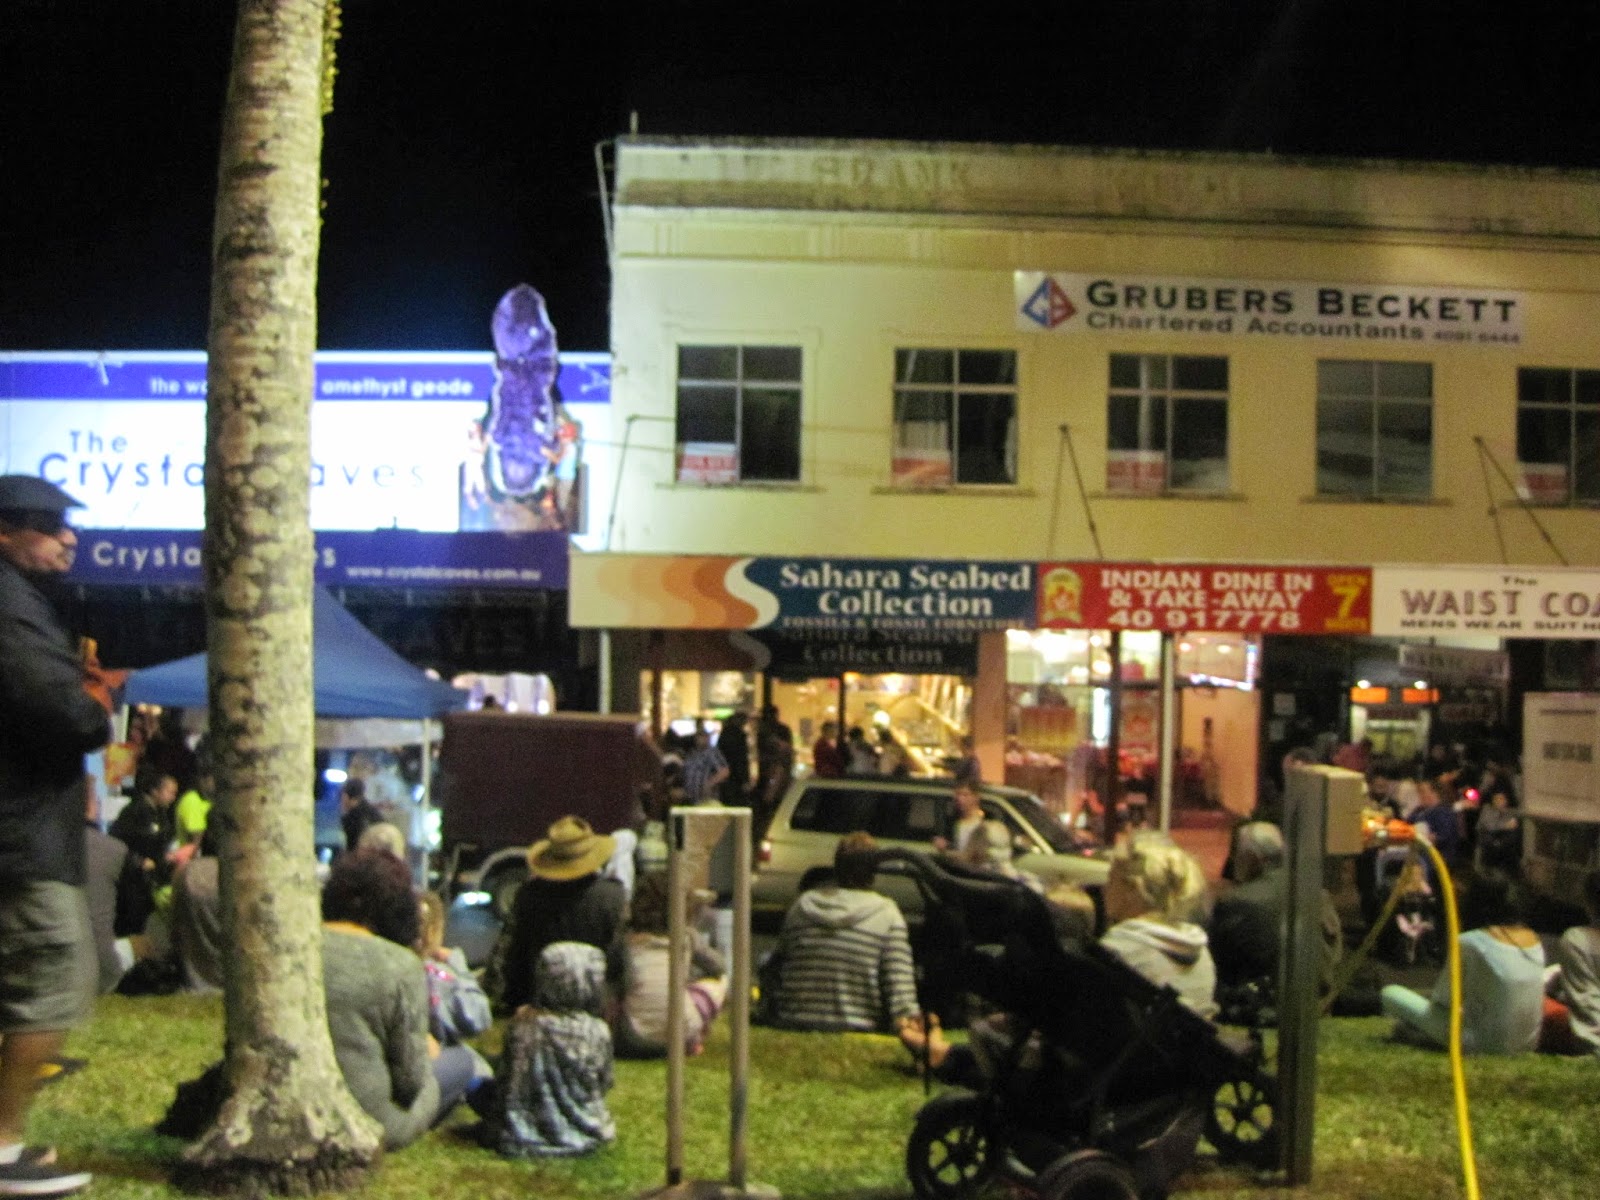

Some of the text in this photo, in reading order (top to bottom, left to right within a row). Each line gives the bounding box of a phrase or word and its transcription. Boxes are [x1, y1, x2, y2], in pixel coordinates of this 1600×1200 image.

[1087, 279, 1518, 322] GRUBERS BECKETT
[1087, 312, 1233, 335] Chartered
[1248, 317, 1424, 341] Accountants
[150, 377, 181, 395] the
[321, 378, 474, 398] amethyst geode
[69, 430, 128, 453] The
[38, 452, 424, 495] Crysta aves
[92, 540, 202, 572] Crysta
[780, 562, 1031, 592] Sahara Seabed
[1101, 569, 1314, 592] INDIAN DINE IN
[1502, 576, 1538, 586] The
[818, 591, 993, 617] Collection
[1108, 588, 1132, 608] &
[1332, 586, 1361, 619] 7
[1400, 588, 1523, 616] WAIST
[1107, 609, 1301, 629] 40 917778
[1400, 618, 1457, 630] MENS
[1464, 618, 1523, 630] WEAR
[803, 643, 944, 664] Collection
